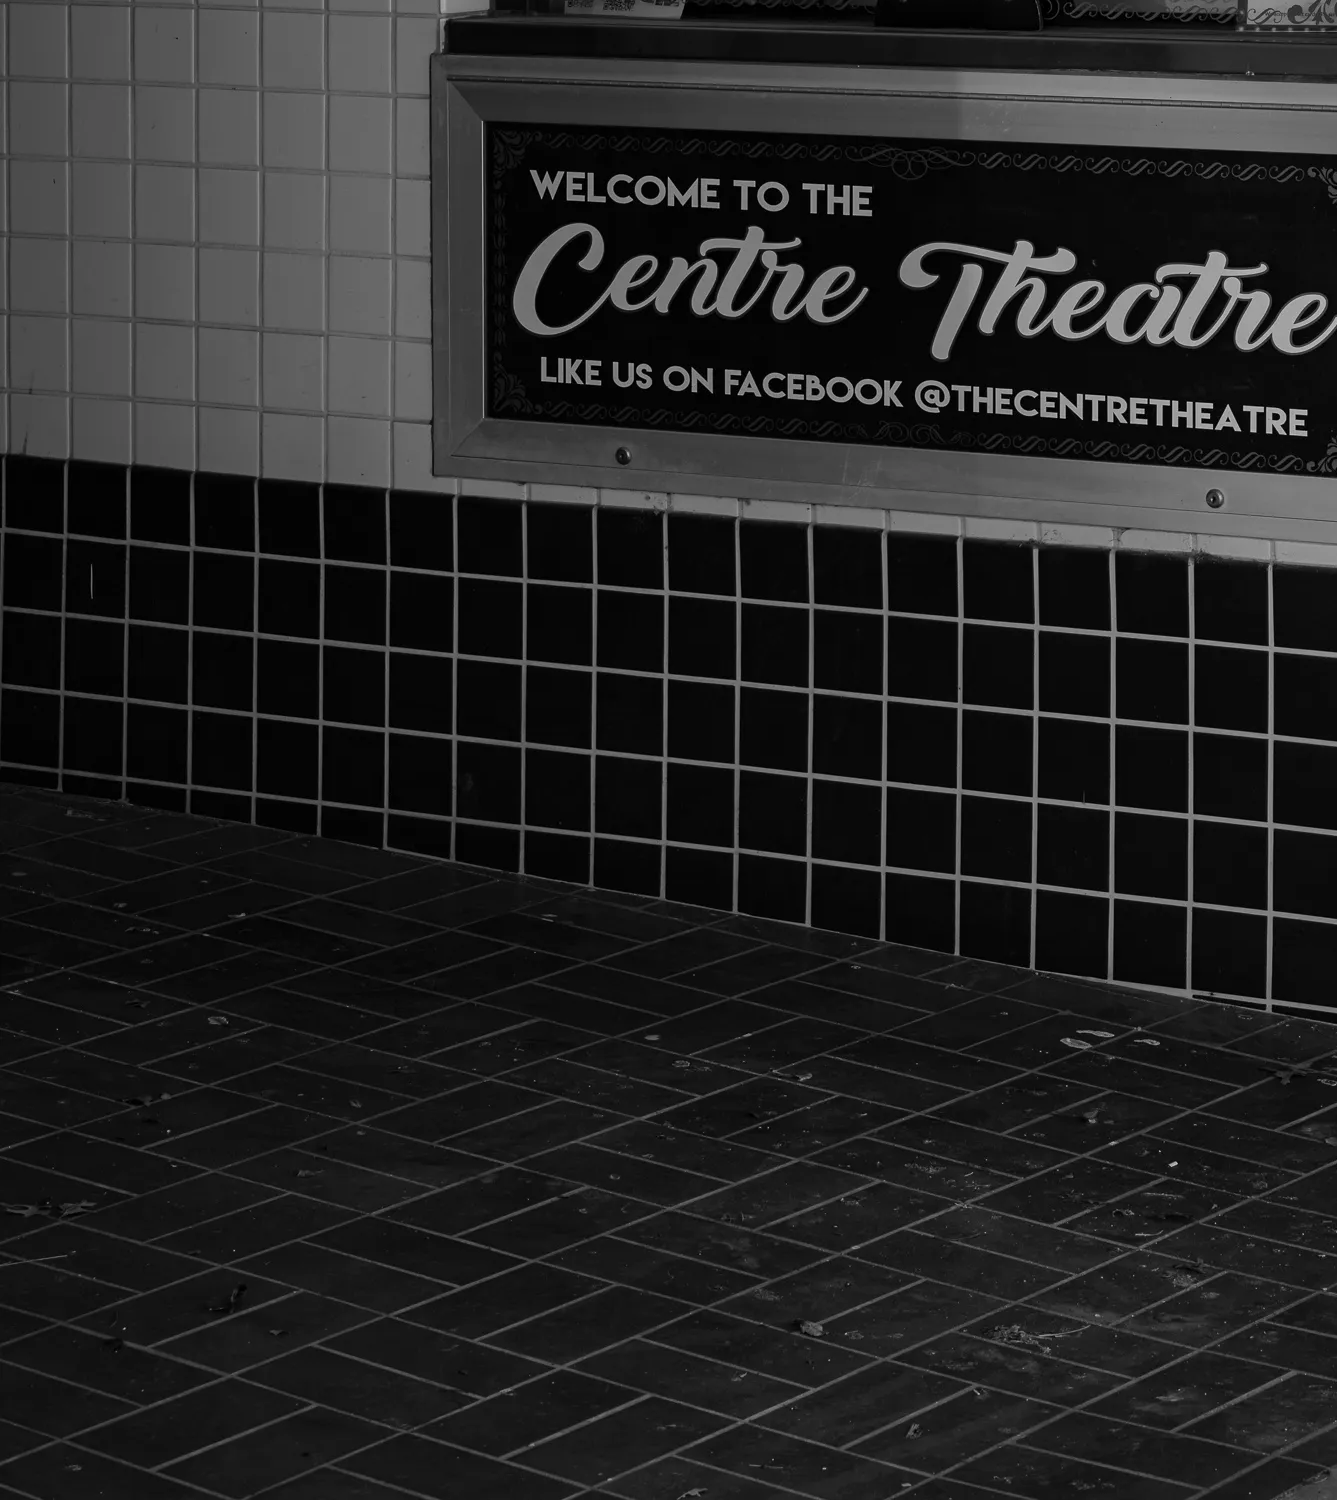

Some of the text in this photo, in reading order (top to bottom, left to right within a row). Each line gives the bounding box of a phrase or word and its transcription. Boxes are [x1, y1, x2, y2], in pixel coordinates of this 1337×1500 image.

[530, 170, 872, 216] WELCOME TO THE
[514, 223, 868, 335] Centre
[541, 357, 1307, 436] LIKE US ON FACEBOOK @THECENTRETHEATRE
